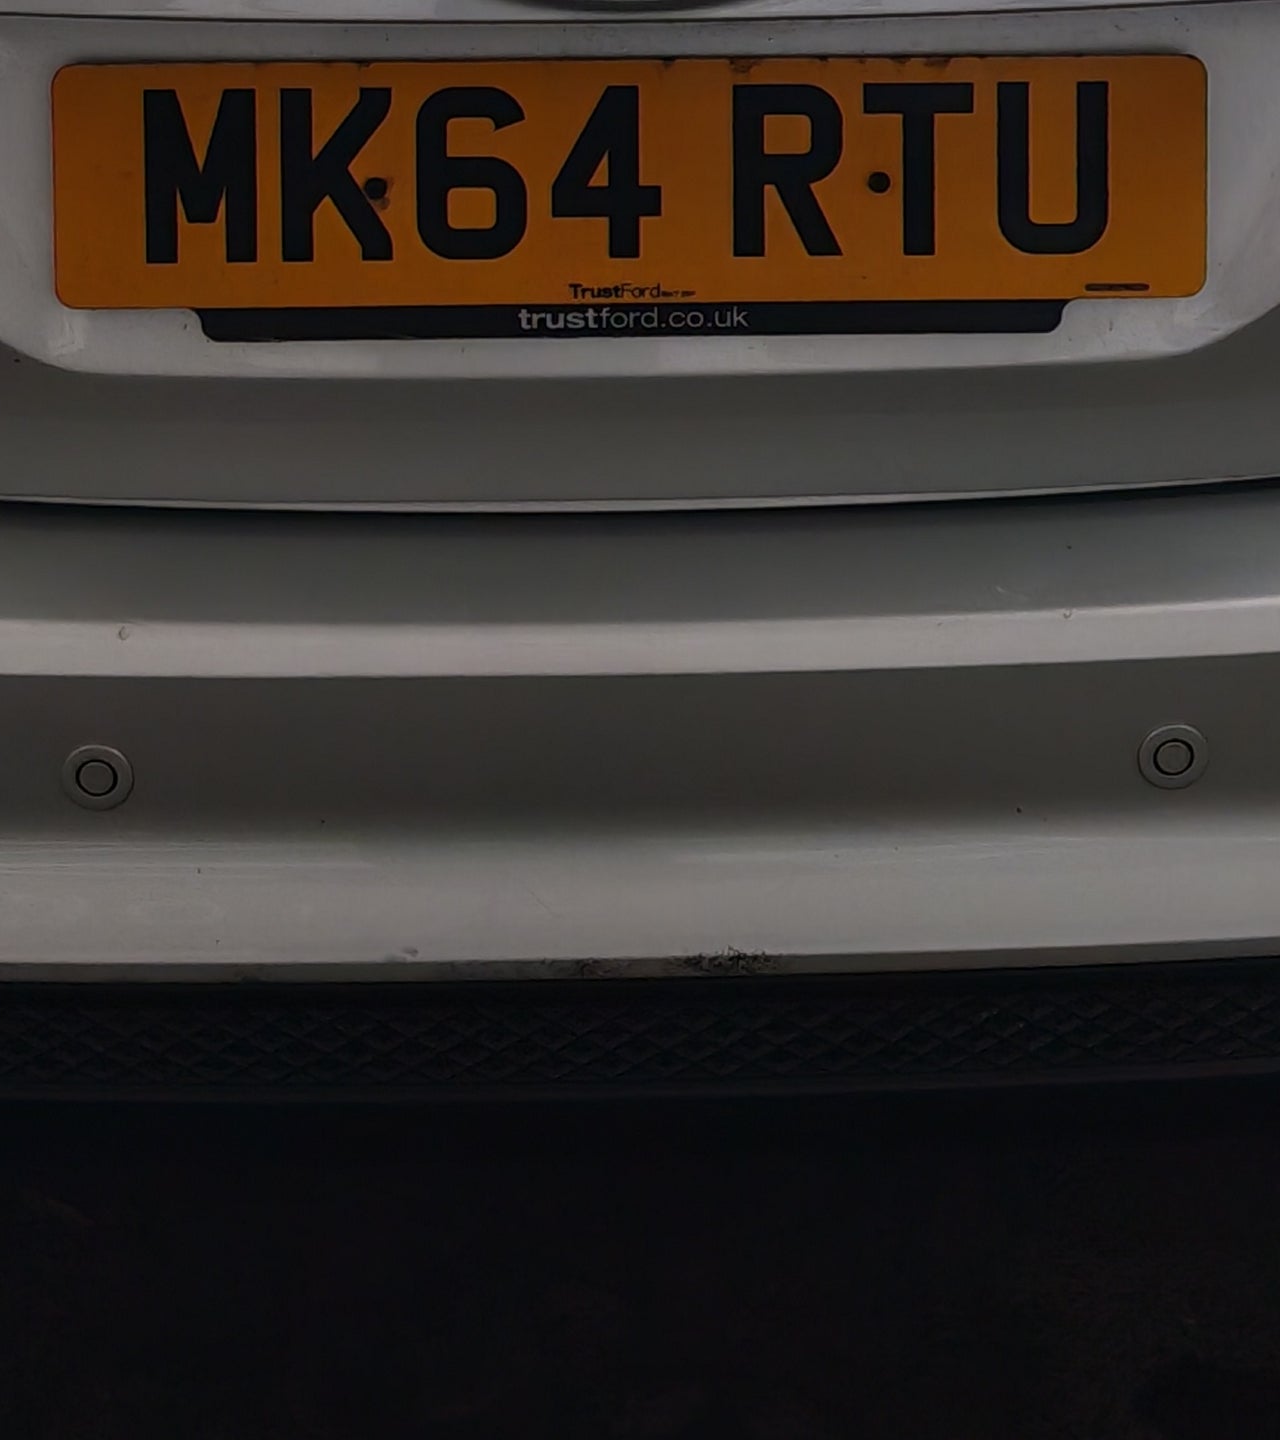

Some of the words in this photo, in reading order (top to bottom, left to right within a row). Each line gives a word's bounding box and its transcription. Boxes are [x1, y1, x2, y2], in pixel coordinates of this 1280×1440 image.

[143, 82, 661, 264] MK64
[732, 81, 1108, 258] RTU
[569, 283, 662, 300] TrustFord
[518, 306, 749, 329] trustford.co.uk
